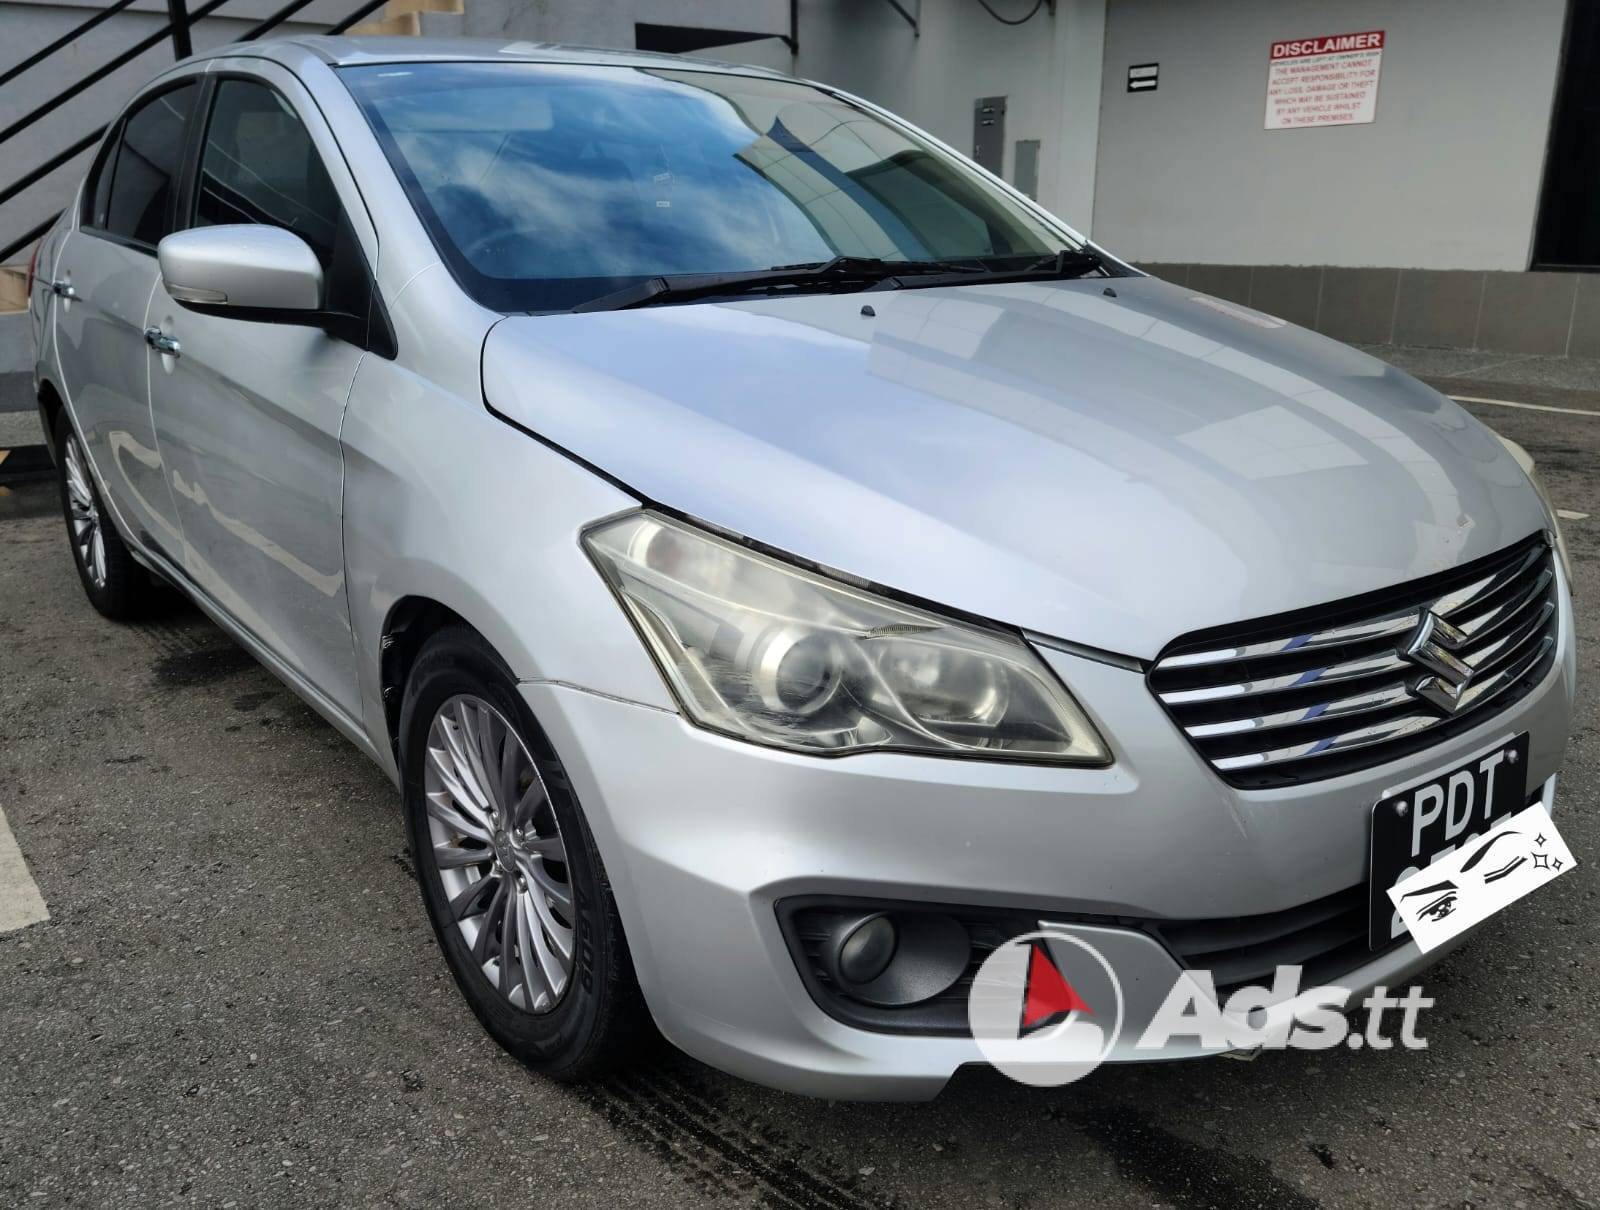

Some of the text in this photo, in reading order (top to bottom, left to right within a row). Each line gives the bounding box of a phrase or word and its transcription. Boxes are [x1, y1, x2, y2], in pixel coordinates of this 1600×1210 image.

[1273, 33, 1381, 57] DISCLAIMER
[1290, 63, 1339, 73] MANAGEMENT
[1341, 59, 1372, 69] CANNOT
[1302, 72, 1358, 83] RESPONSIBILITY
[1412, 750, 1505, 857] PDT
